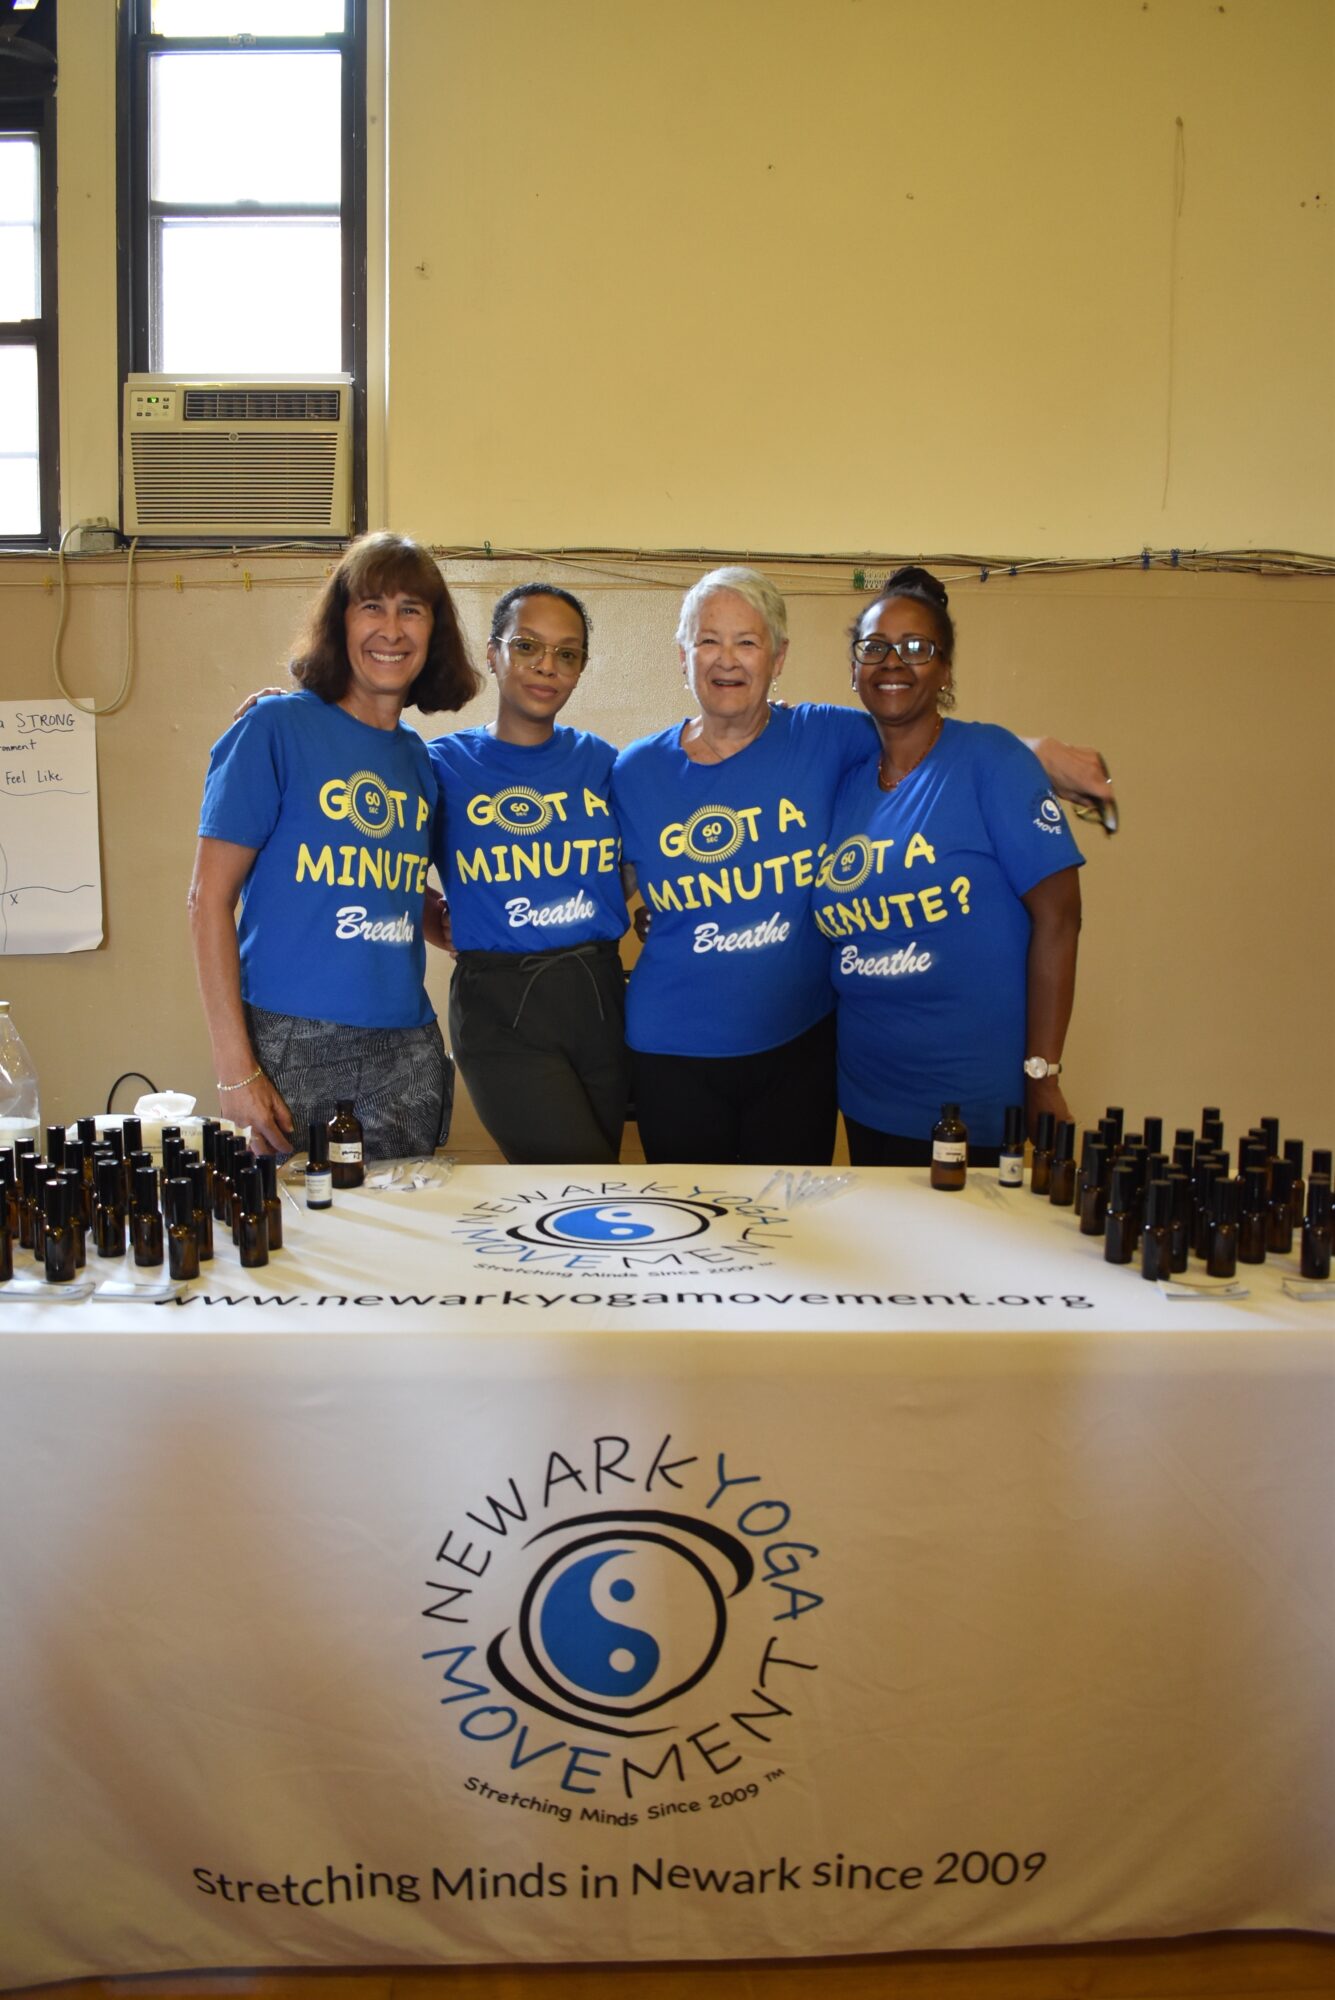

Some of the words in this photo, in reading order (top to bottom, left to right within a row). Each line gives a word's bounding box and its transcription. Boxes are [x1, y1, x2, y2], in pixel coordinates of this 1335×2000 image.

[16, 712, 75, 728] STRONG
[5, 770, 26, 785] Feel
[37, 770, 63, 784] Like
[365, 791, 380, 806] 60
[583, 787, 609, 817] A
[702, 822, 721, 837] 60
[778, 798, 806, 833] A
[1032, 818, 1062, 835] MOVE
[841, 850, 856, 866] 60
[904, 832, 935, 869] A
[505, 889, 595, 928] Breathe
[693, 910, 791, 954] Breathe
[840, 941, 932, 976] Breathe
[473, 1263, 573, 1278] Stretching
[422, 1636, 818, 1799] MOVEMENT
[464, 1776, 572, 1822] Stretching
[580, 1808, 639, 1827] Minds
[647, 1801, 701, 1819] Since
[708, 1783, 759, 1809] 2009
[193, 1862, 421, 1907] Stretching
[432, 1862, 567, 1900] Minds
[581, 1864, 618, 1899] in
[632, 1857, 802, 1895] Newark
[812, 1853, 923, 1890] since
[933, 1851, 1047, 1886] 2009
